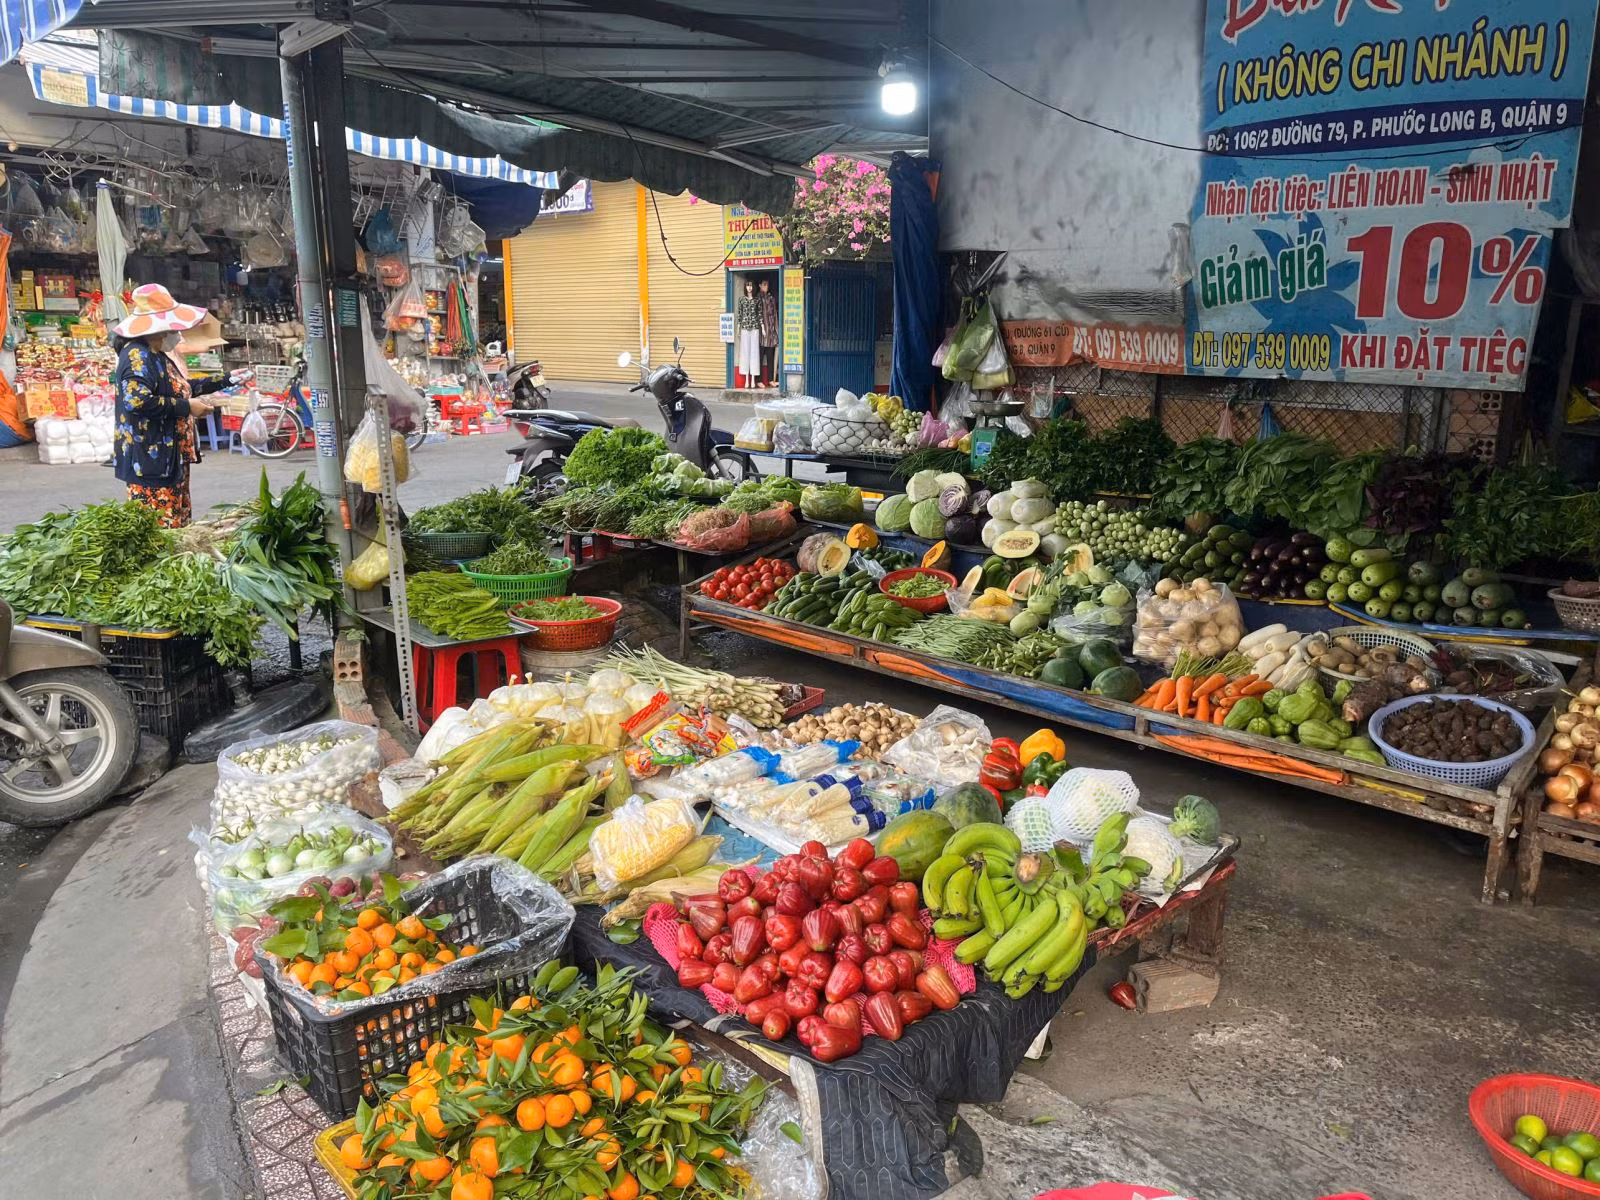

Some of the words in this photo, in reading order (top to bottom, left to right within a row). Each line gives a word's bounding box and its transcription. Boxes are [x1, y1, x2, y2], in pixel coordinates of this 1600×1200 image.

[1349, 40, 1404, 91] CHI
[1233, 130, 1268, 151] 106/2
[1272, 124, 1322, 147] ĐƯỜNG
[1327, 122, 1348, 145] 79,
[1353, 120, 1367, 140] P.
[1371, 110, 1427, 138] PHƯỚC
[1430, 112, 1476, 133] LONG
[1480, 108, 1496, 133] B,
[1501, 101, 1551, 133] QUẬN
[1556, 103, 1568, 125] 9
[1205, 180, 1246, 223] Nhận
[1250, 177, 1279, 221] đặt
[1283, 174, 1325, 219] tiệc:
[1327, 164, 1370, 210] LIÊN
[1374, 168, 1427, 206] HOAN
[1446, 162, 1490, 203] SINH
[1497, 152, 1557, 210] NHẬT
[1200, 244, 1271, 310] Giảm
[1278, 228, 1327, 303] giá
[1051, 343, 1056, 353] 9
[1096, 328, 1115, 359] 097
[1119, 330, 1141, 362] 539
[1144, 332, 1178, 364] 0009
[1192, 331, 1219, 367] ĐT:
[1222, 332, 1251, 369] 097
[1255, 333, 1286, 370] 539
[1289, 334, 1331, 372] 0009
[1341, 333, 1386, 369] KHI
[1394, 327, 1451, 381] ĐẶT
[1459, 328, 1527, 384] TIỆC
